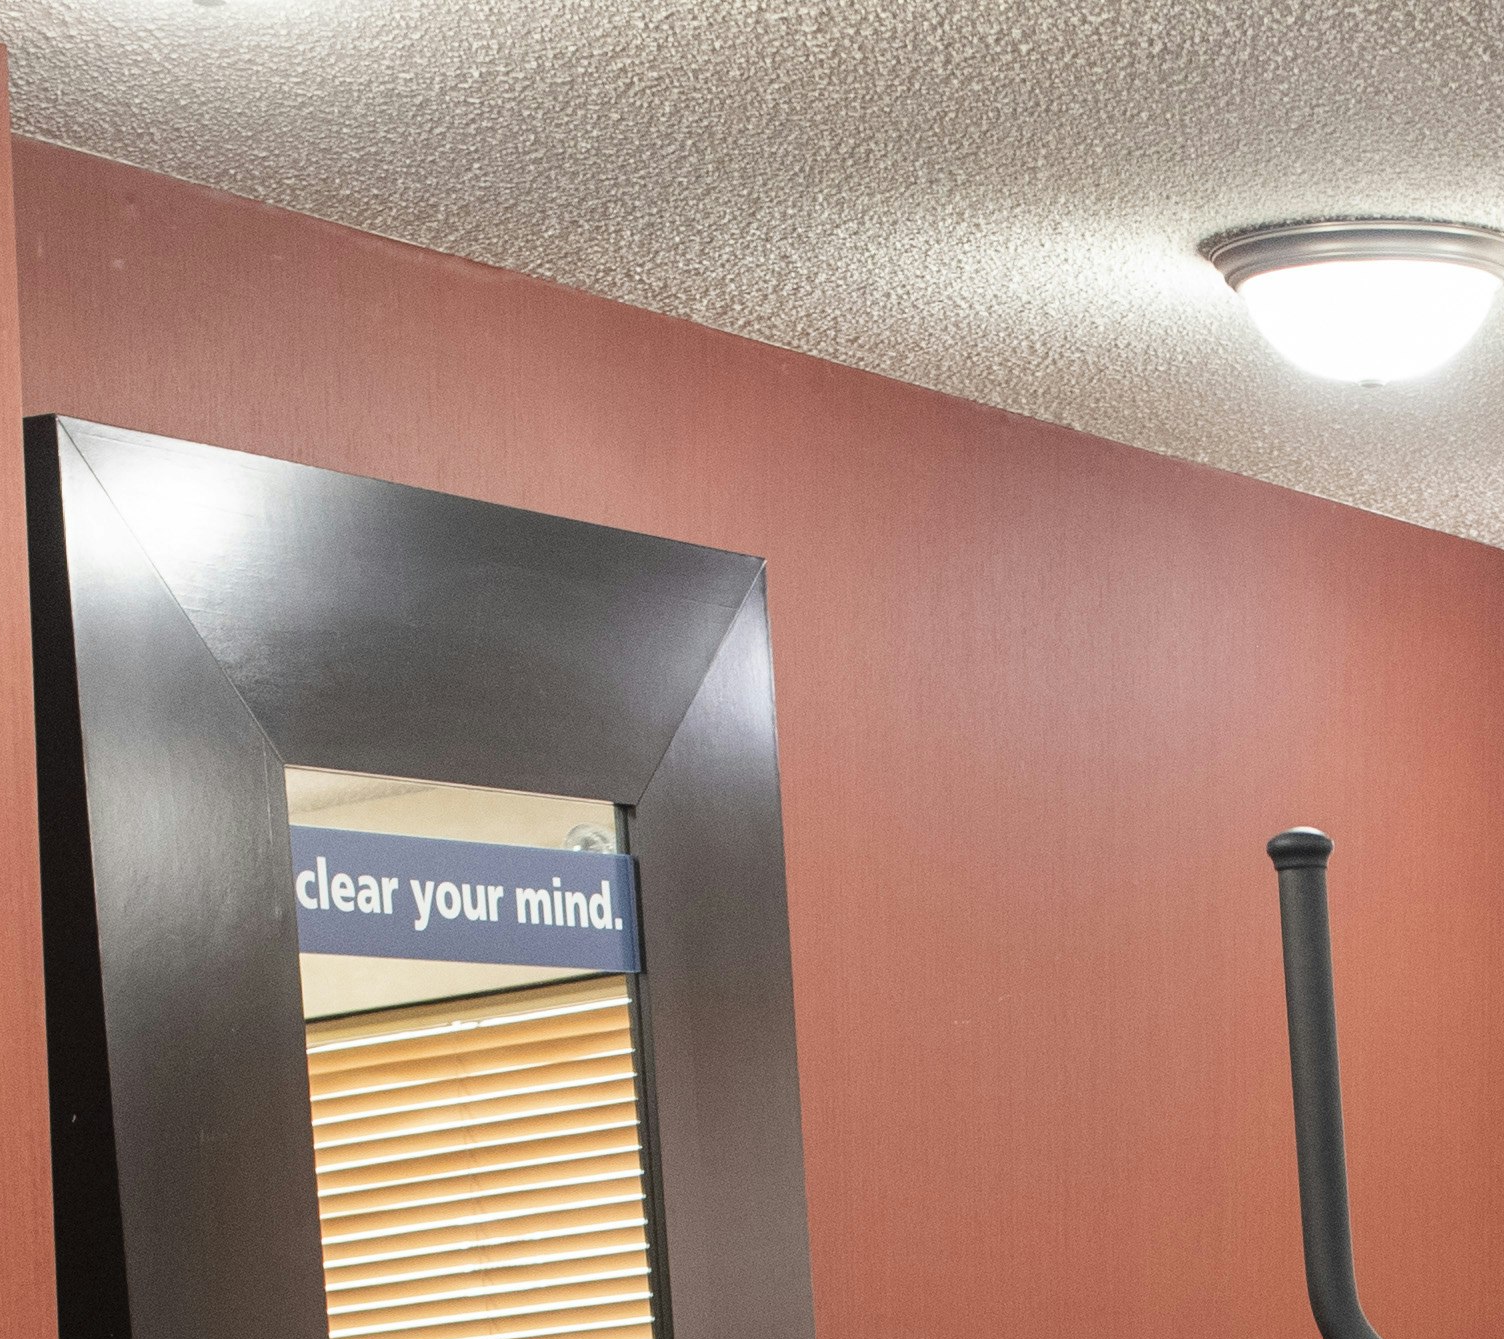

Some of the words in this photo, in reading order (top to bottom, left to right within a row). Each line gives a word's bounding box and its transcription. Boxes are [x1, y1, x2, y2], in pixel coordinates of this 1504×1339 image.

[295, 856, 398, 914] clear
[410, 879, 503, 932] your
[515, 877, 623, 931] mind.
